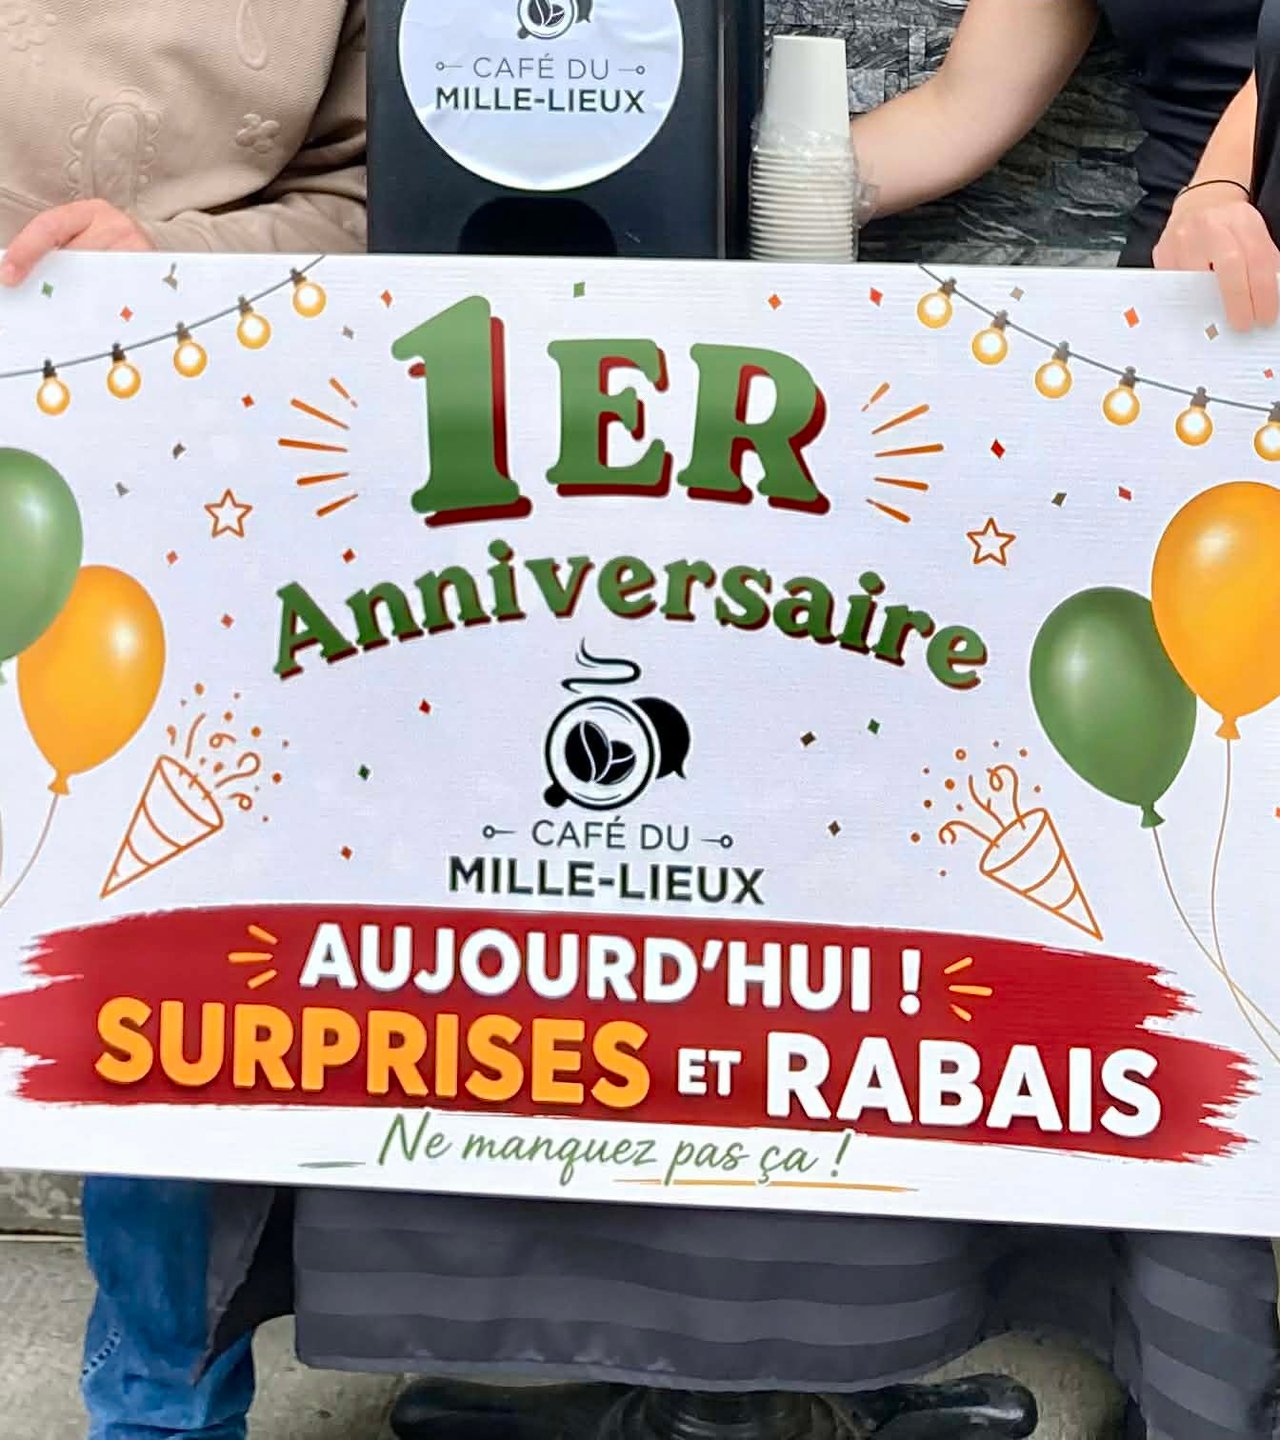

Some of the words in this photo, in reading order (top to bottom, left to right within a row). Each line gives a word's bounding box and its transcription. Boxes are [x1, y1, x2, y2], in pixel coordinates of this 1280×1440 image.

[436, 86, 646, 114] MILLE-LIEUX
[473, 53, 555, 80] CAFÉ
[568, 58, 609, 81] DU
[390, 294, 831, 528] 1ER
[272, 538, 988, 691] Anniversaire
[531, 816, 626, 849] CAFÉ
[640, 823, 690, 851] DU
[448, 855, 765, 905] MILLE-LIEUX
[299, 922, 871, 1013] AUJOURD'HUI
[94, 996, 651, 1109] SURPRISES
[677, 1047, 742, 1097] ET
[766, 1031, 1162, 1138] RABAIS
[378, 1112, 452, 1166] Ne
[462, 1135, 658, 1187] manquez
[664, 1140, 750, 1187] pas
[756, 1142, 819, 1186] ça
